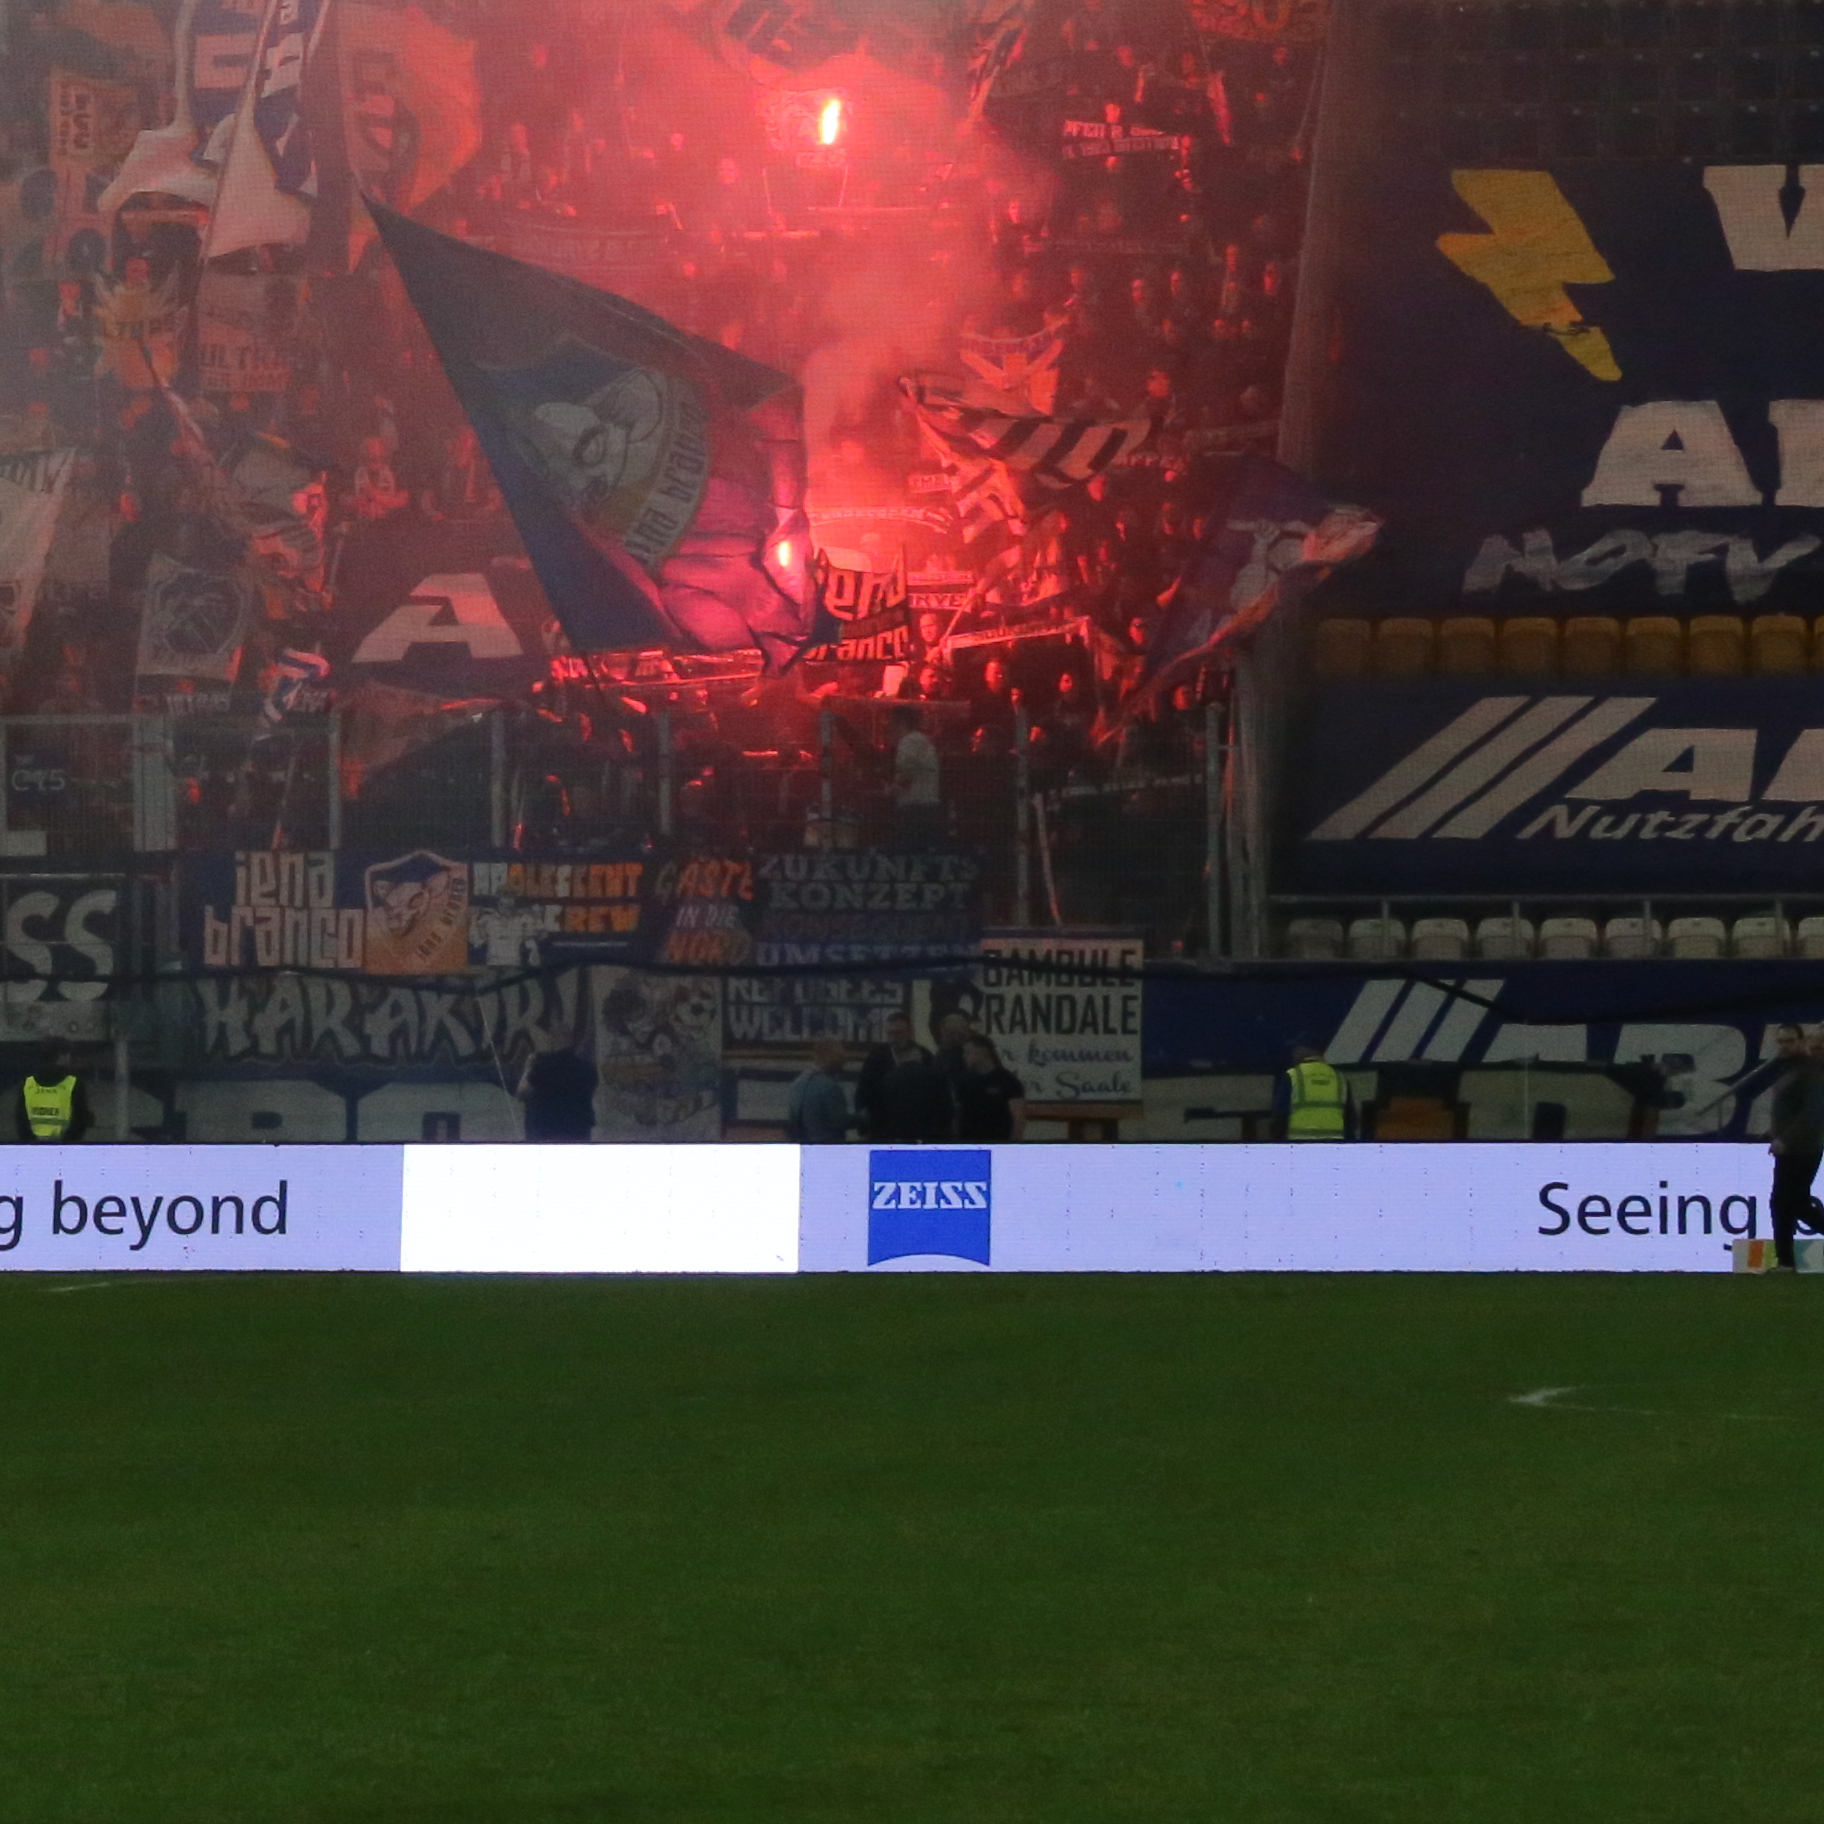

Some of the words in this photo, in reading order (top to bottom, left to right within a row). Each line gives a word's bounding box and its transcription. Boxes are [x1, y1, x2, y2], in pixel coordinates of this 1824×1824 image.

[767, 881, 971, 911] KONZEPT
[204, 905, 363, 968] branco
[984, 993, 1139, 1035] RANDALE
[52, 1179, 289, 1252] beyond
[870, 1179, 989, 1210] ZEISS
[1538, 1181, 1757, 1251] Seeing
